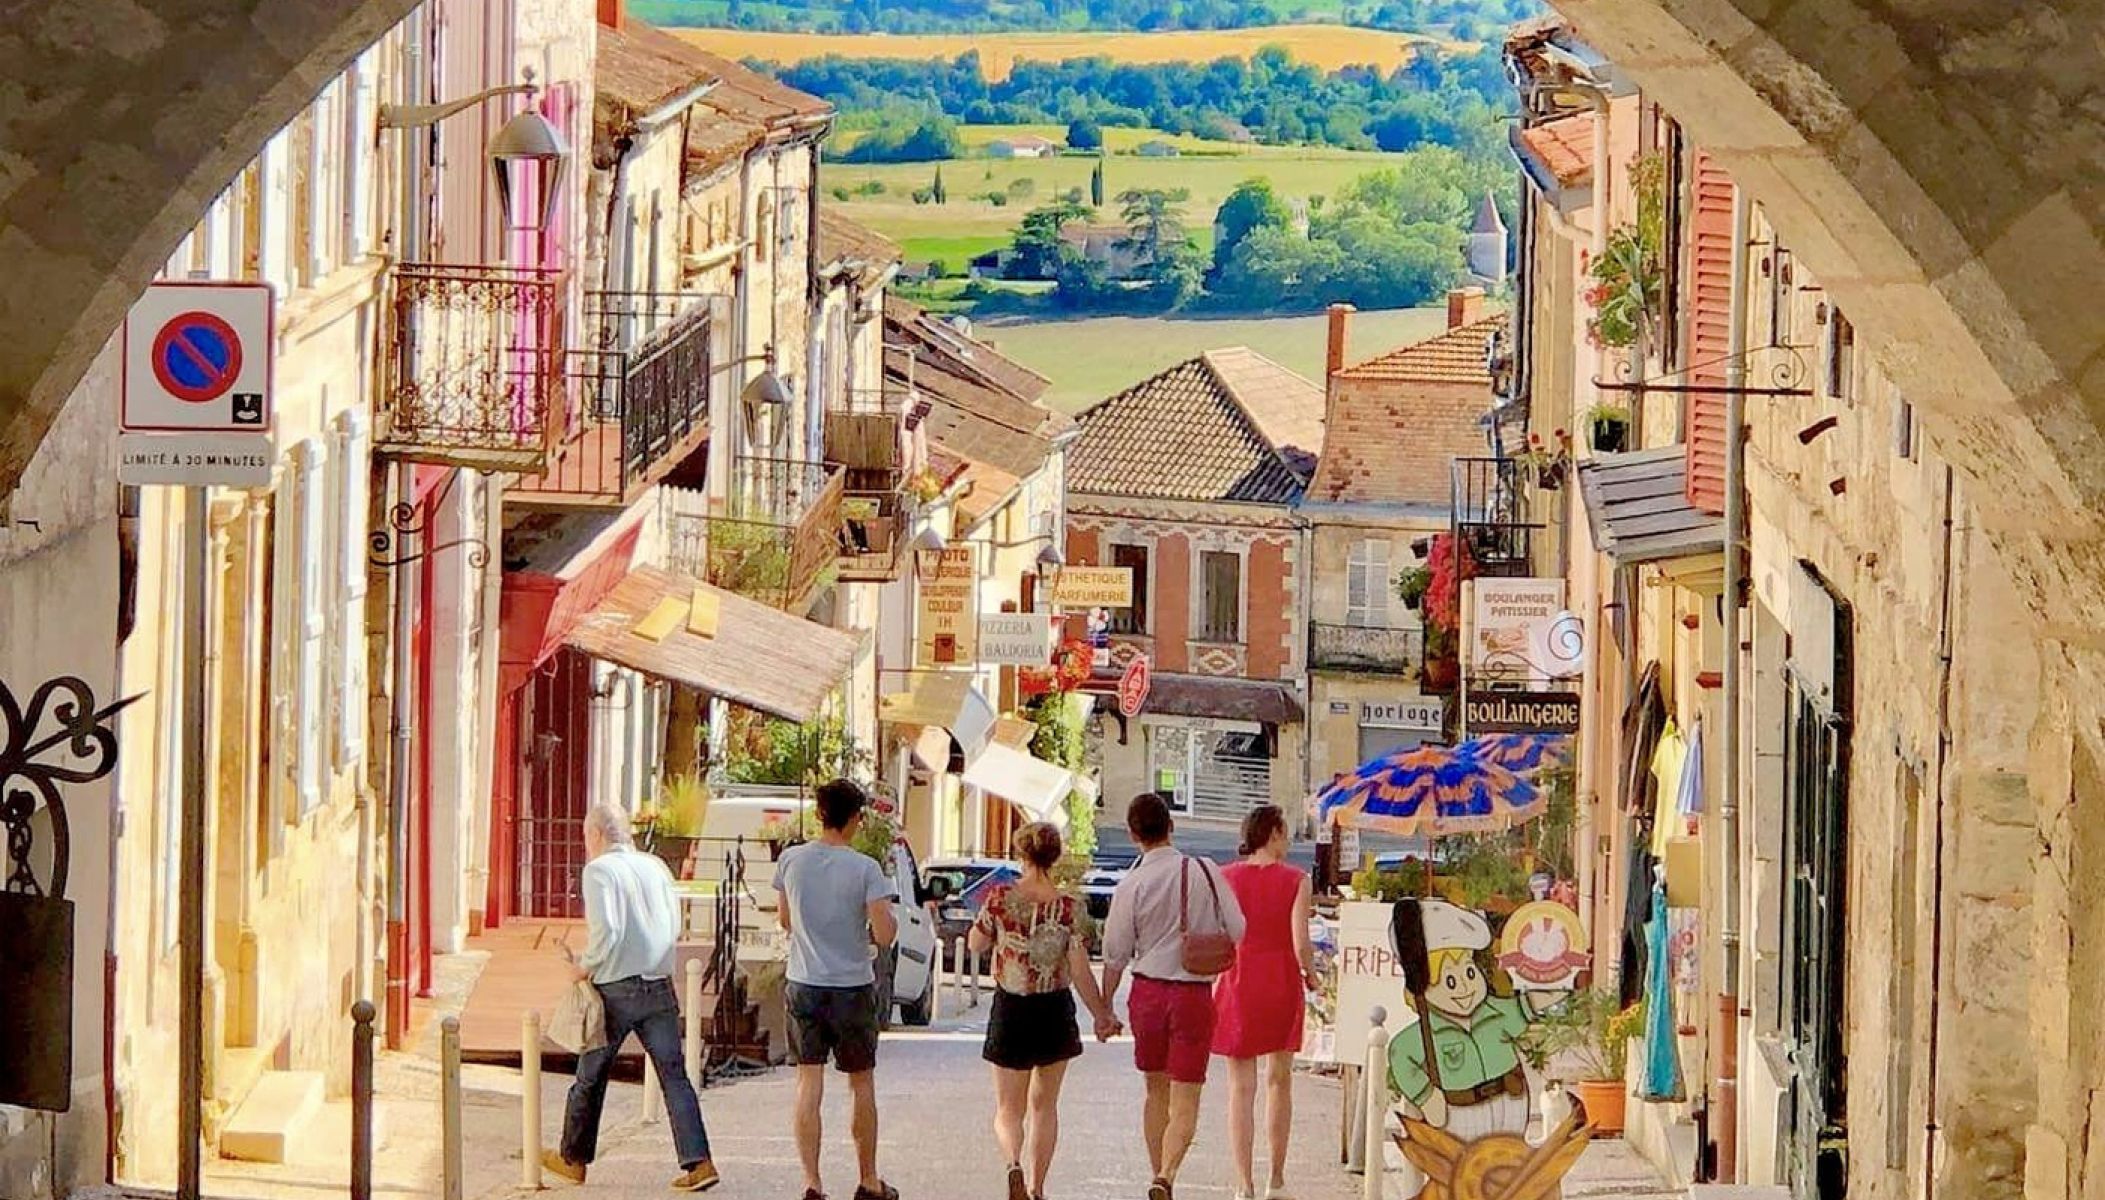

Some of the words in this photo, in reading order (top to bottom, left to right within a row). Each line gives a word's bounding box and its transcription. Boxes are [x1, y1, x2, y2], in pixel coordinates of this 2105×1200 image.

[122, 452, 165, 465] LIMITÉ
[186, 456, 201, 465] 30
[207, 456, 266, 467] MINUTES
[925, 549, 969, 561] PHOTO
[1051, 589, 1127, 602] PARFUMERIE
[1483, 593, 1556, 604] BOULANGER
[1491, 606, 1548, 617] PATISSIER
[984, 643, 1045, 658] BALDORIA
[1362, 702, 1440, 726] horloge
